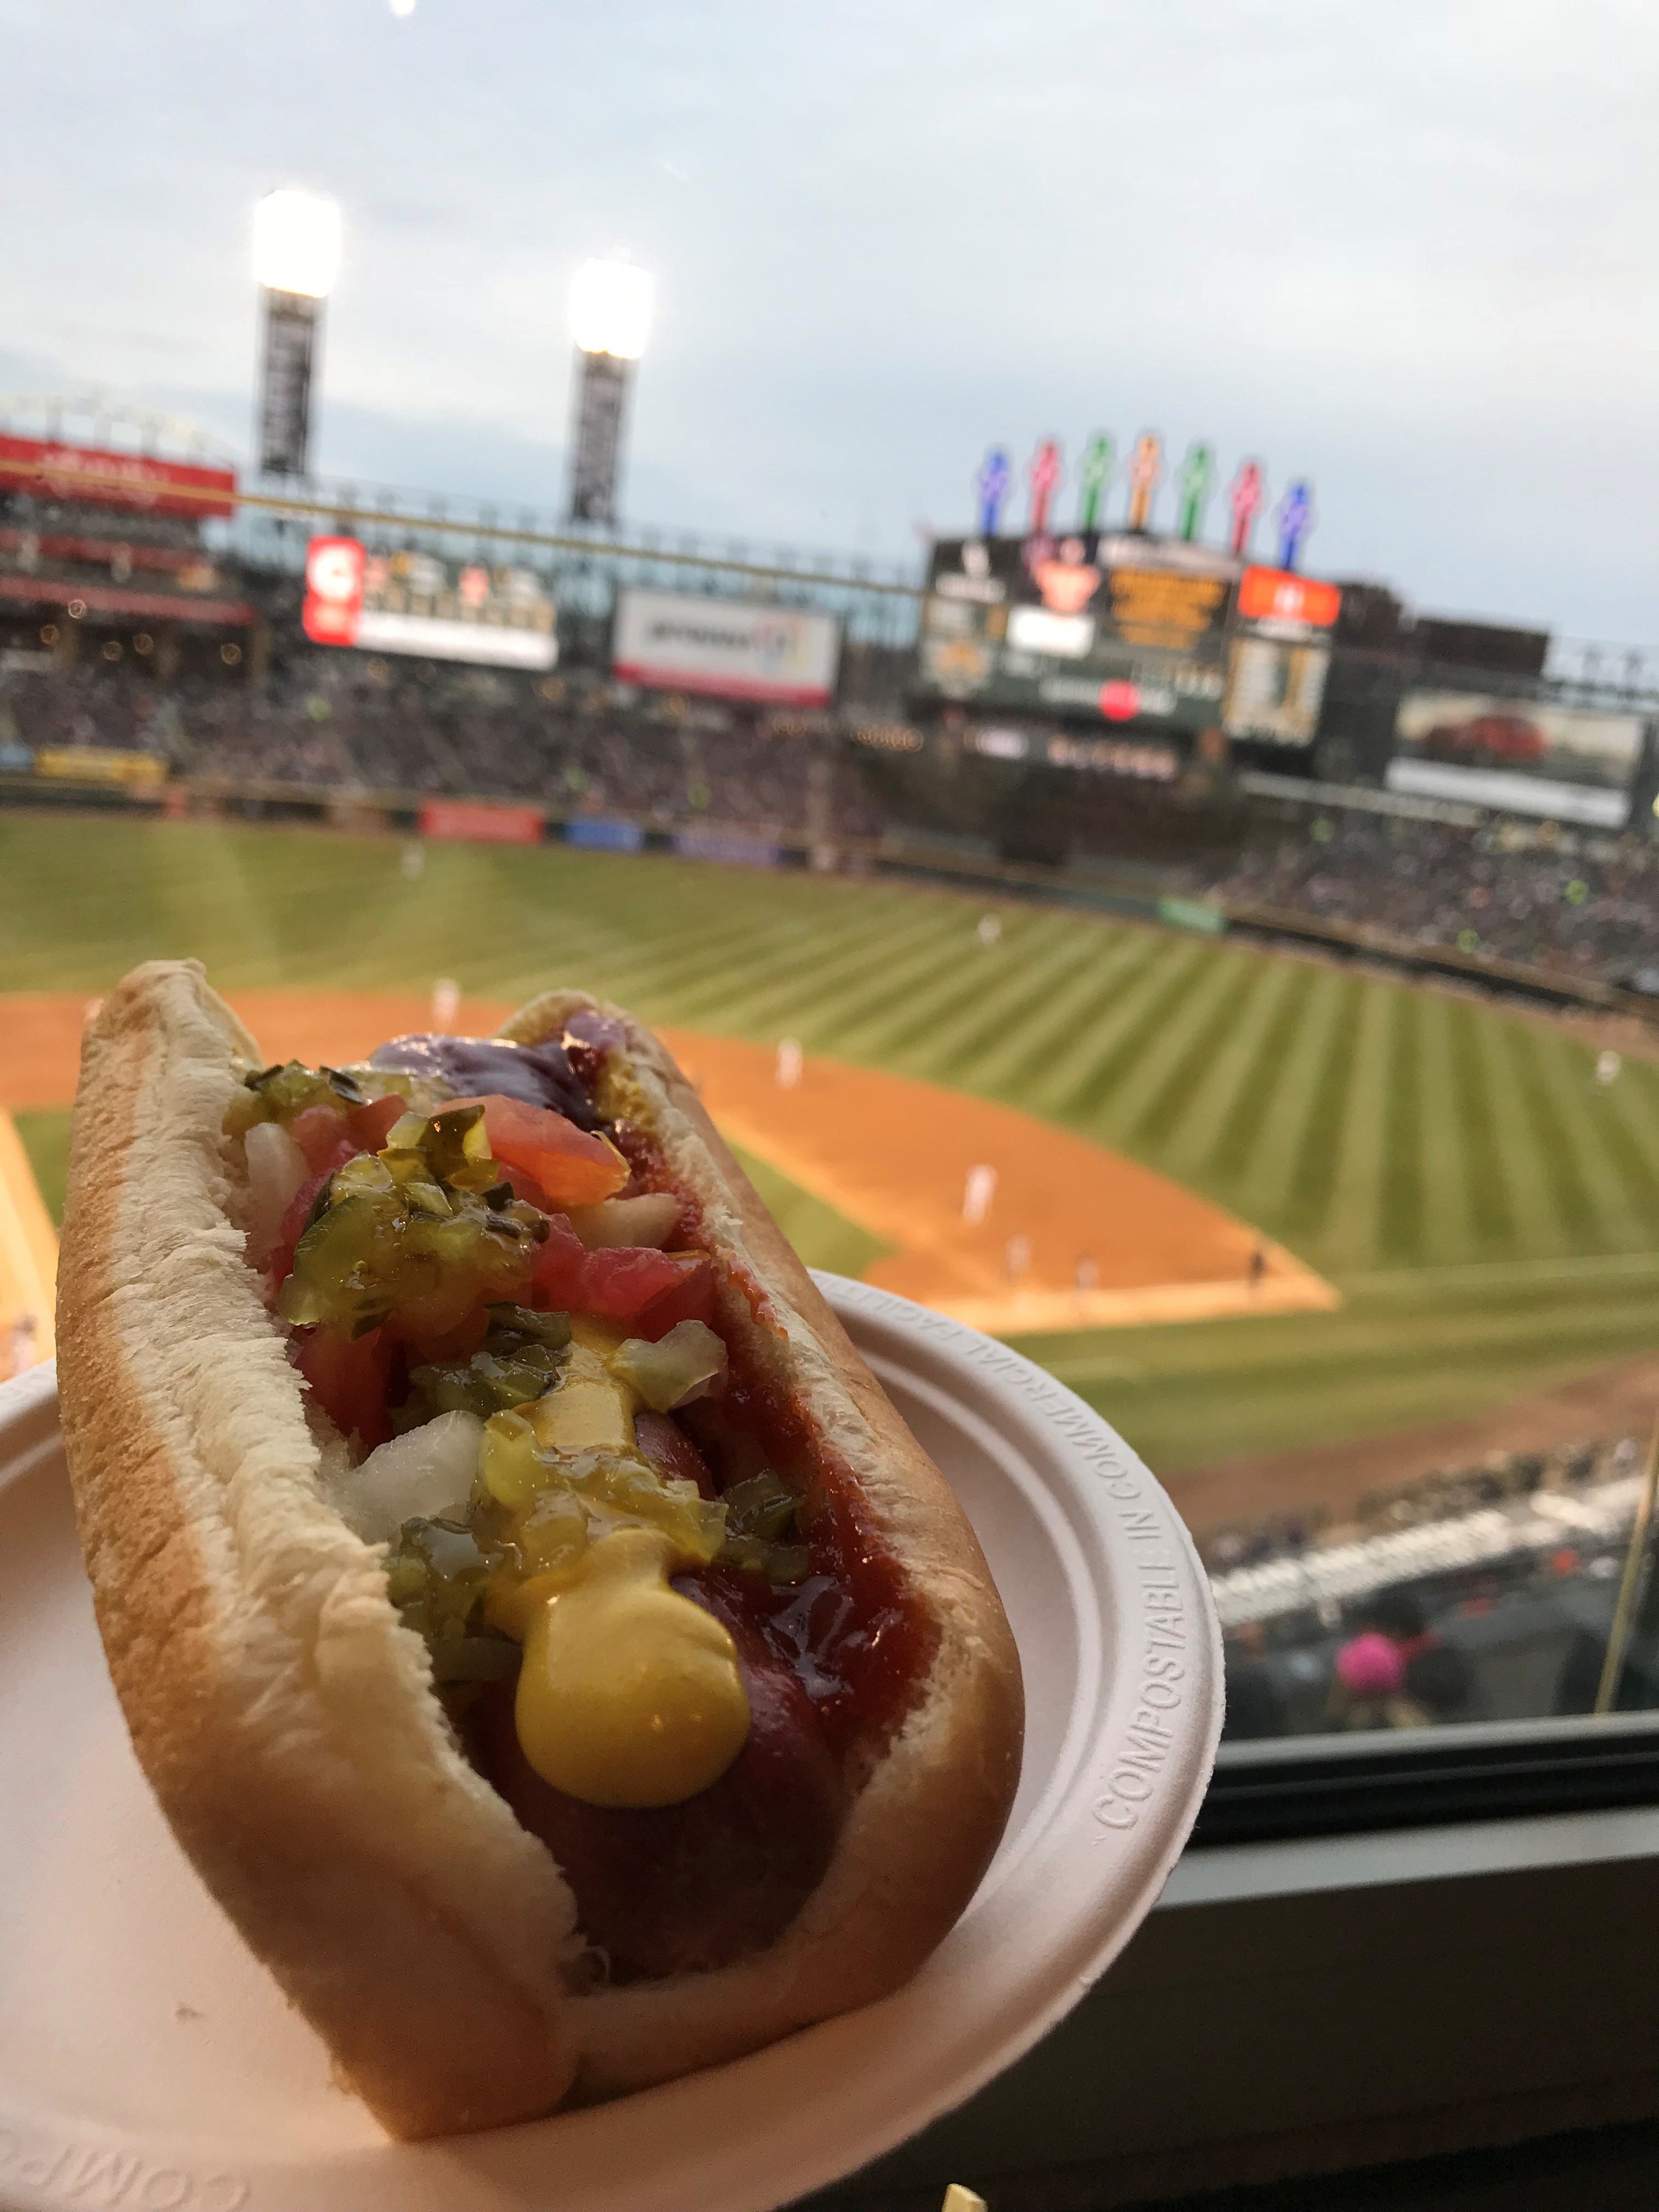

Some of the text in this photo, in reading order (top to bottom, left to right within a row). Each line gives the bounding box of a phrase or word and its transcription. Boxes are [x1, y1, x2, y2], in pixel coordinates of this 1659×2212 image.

[966, 1339, 1142, 1500] COMMERCIAL
[1117, 1510, 1163, 1540] IN
[1091, 1549, 1187, 1831] COMPOSTABLE
